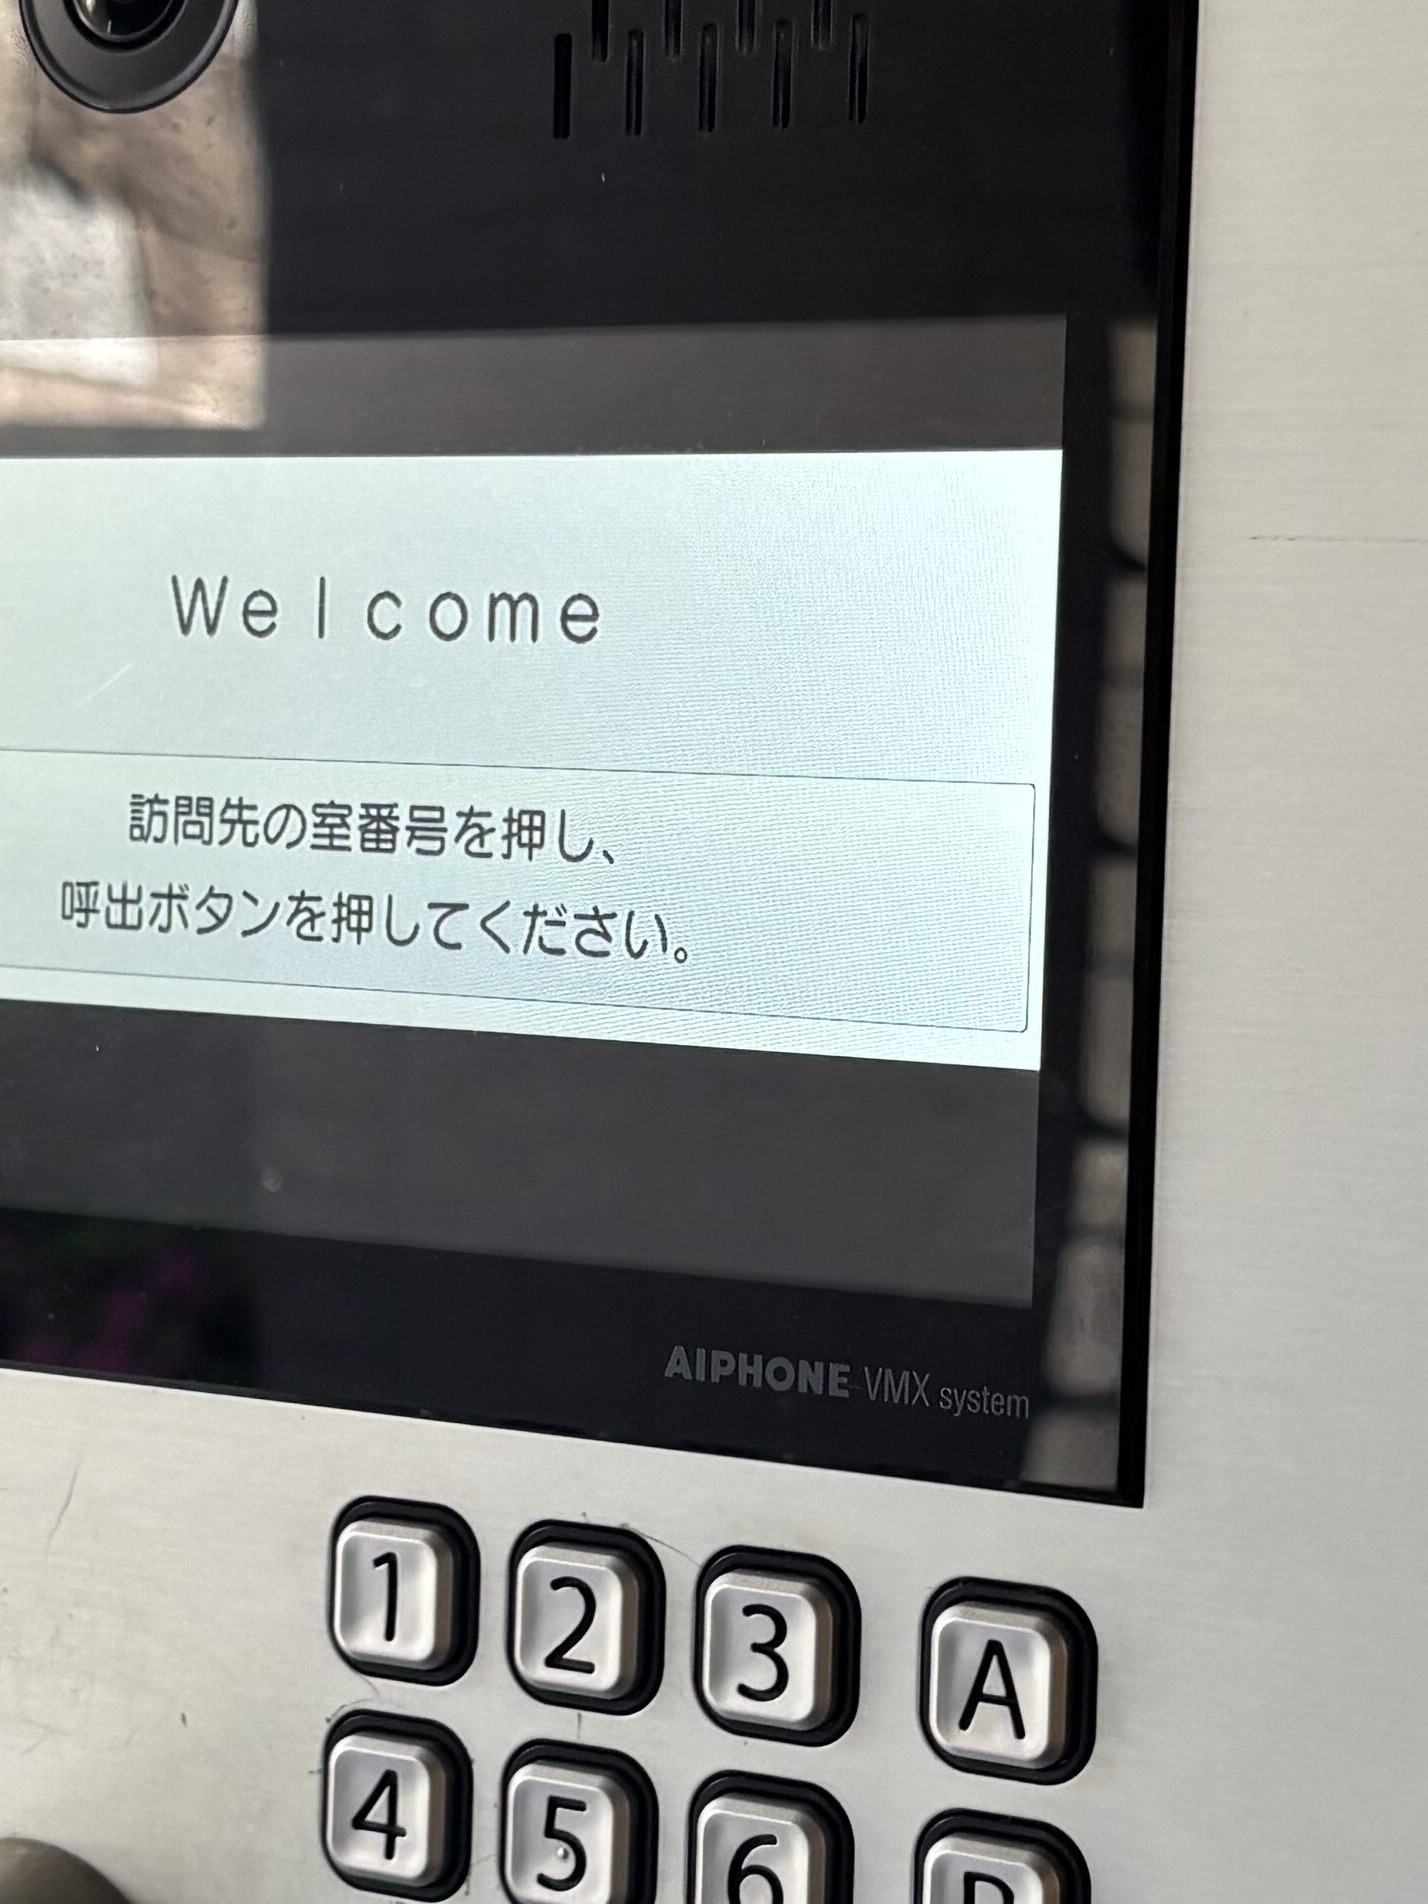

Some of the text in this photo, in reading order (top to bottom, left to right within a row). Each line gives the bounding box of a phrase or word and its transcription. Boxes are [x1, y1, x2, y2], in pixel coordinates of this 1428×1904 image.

[172, 575, 599, 644] Welcome
[130, 794, 614, 864] 訪問先の室番号を押し、
[62, 881, 688, 963] 呼出ボタンを押してください。
[665, 1346, 1029, 1418] AIPHONE VMX system
[373, 1552, 1025, 1739] 1 2 3 A
[351, 1769, 406, 1861] 4
[537, 1795, 586, 1891] 5
